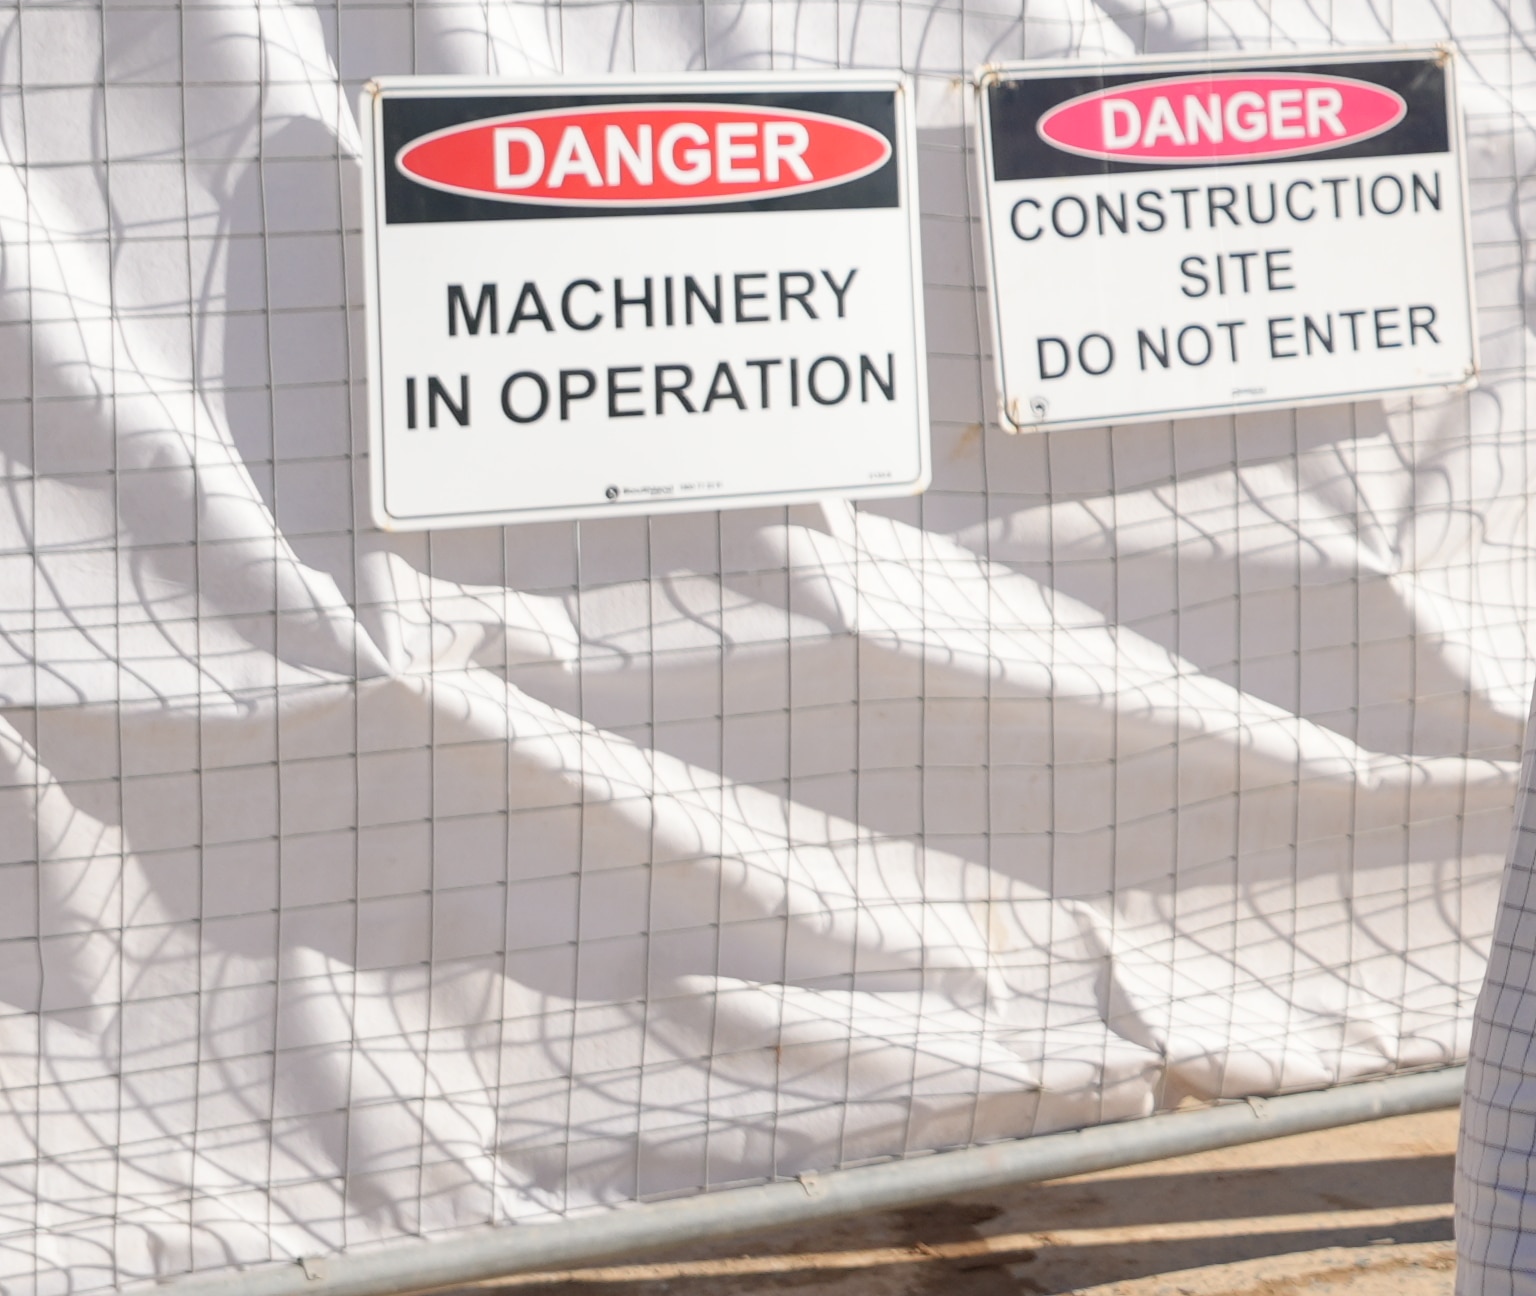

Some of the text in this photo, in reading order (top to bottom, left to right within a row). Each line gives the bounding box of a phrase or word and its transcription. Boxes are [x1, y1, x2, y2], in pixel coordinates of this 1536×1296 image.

[1101, 86, 1347, 150] DANGER
[492, 120, 814, 190] DANGER
[1009, 170, 1443, 242] CONSTRUCTION
[446, 268, 859, 338] MACHINERY
[1179, 249, 1296, 299] SITE
[1036, 304, 1441, 380] DO NOT ENTER
[405, 352, 897, 431] IN OPERATION
